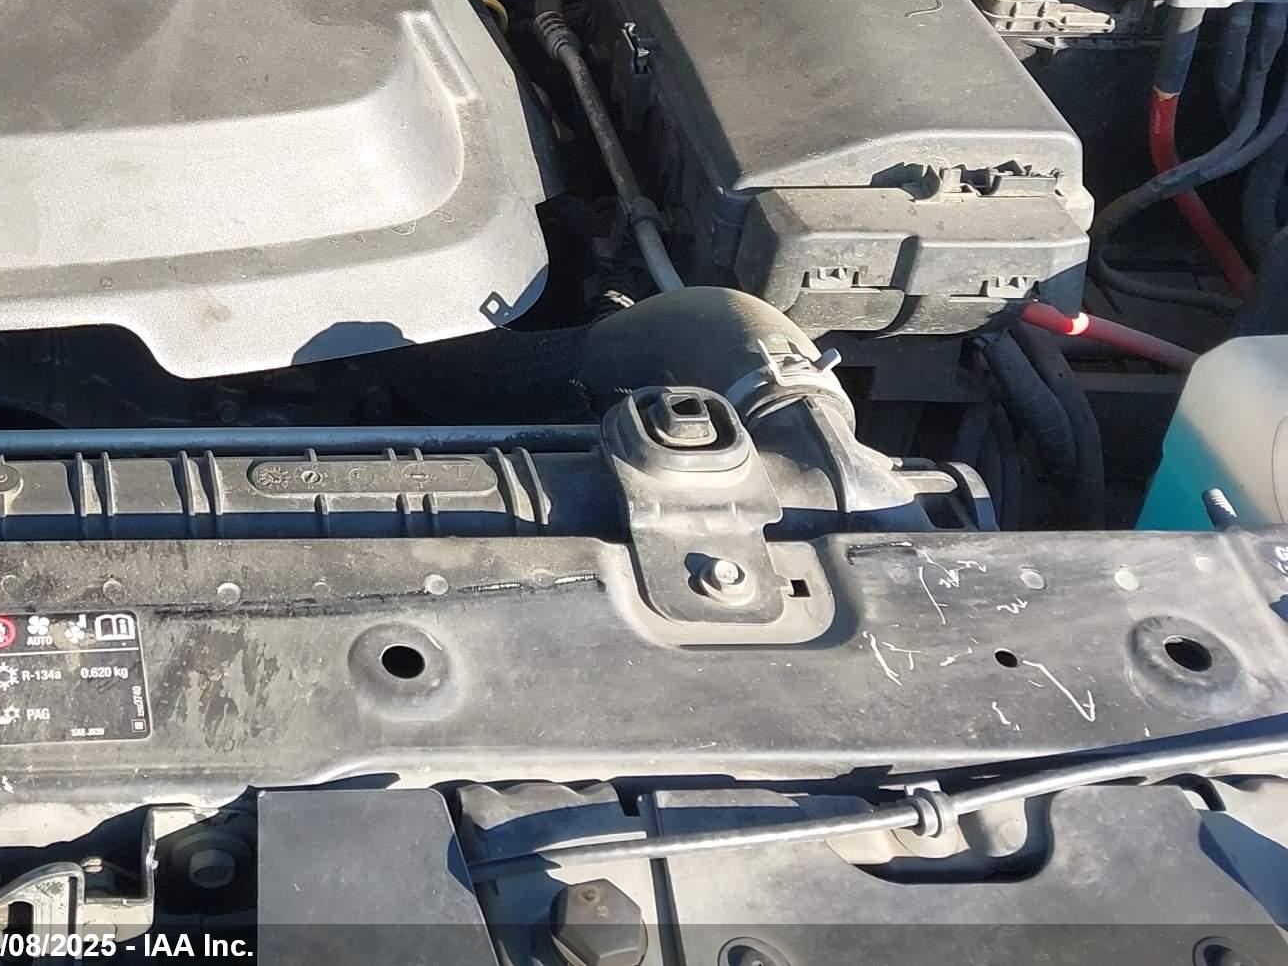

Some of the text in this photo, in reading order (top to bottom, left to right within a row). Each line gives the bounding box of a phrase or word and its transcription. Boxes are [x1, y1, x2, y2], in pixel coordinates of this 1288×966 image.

[27, 635, 53, 646] AUTO
[22, 666, 129, 682] R-134a 0.620 kg
[26, 708, 51, 721] PAG
